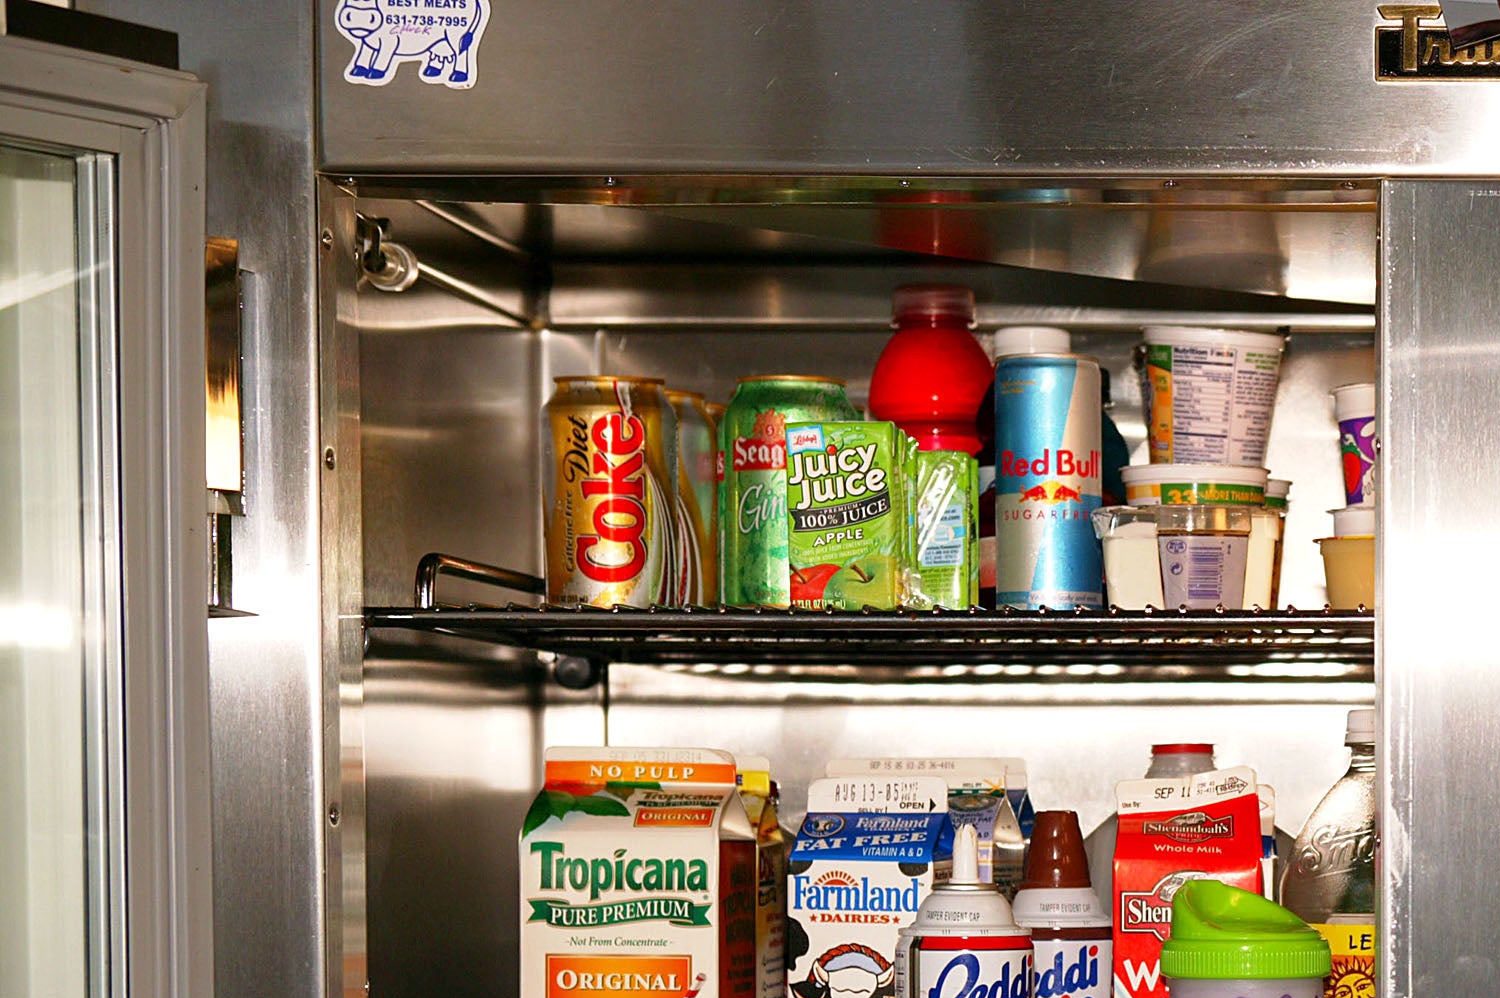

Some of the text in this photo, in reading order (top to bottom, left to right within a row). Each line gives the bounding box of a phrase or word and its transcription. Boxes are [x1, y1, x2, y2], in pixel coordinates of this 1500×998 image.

[387, 0, 466, 9] BEST MEATS
[386, 14, 467, 27] 631-738-7995
[563, 415, 590, 483] Diet
[790, 444, 878, 485] Juicy
[1001, 449, 1099, 479] Red Bull
[576, 412, 647, 583] Coke
[797, 468, 886, 510] Juice
[800, 498, 888, 529] 100% JUICE
[565, 490, 574, 573] Caffeine Free
[813, 528, 864, 548] APPLE
[590, 765, 695, 780] NO PULP
[835, 783, 856, 802] AUG
[1154, 787, 1175, 799] SEP
[1181, 787, 1191, 798] 11
[899, 801, 925, 809] OPEN
[641, 812, 708, 822] ORIGINAL
[856, 816, 930, 828] Farmland
[1148, 822, 1229, 834] Shenandoah's
[795, 832, 929, 851] FAT FREE
[1154, 844, 1222, 854] Whole Milk
[862, 847, 924, 857] VITAMIN A & D
[530, 841, 708, 901] Tropicana
[793, 875, 918, 912] Farmland
[551, 900, 691, 926] PURE PREMIUM
[944, 911, 968, 921] EVIDENT
[969, 912, 980, 921] CAP
[1040, 903, 1082, 913] TAMPER EVIDENT
[820, 913, 890, 924] DAIRIES
[588, 937, 613, 947] From
[614, 937, 668, 947] Concentrate
[556, 969, 682, 991] ORIGINAL
